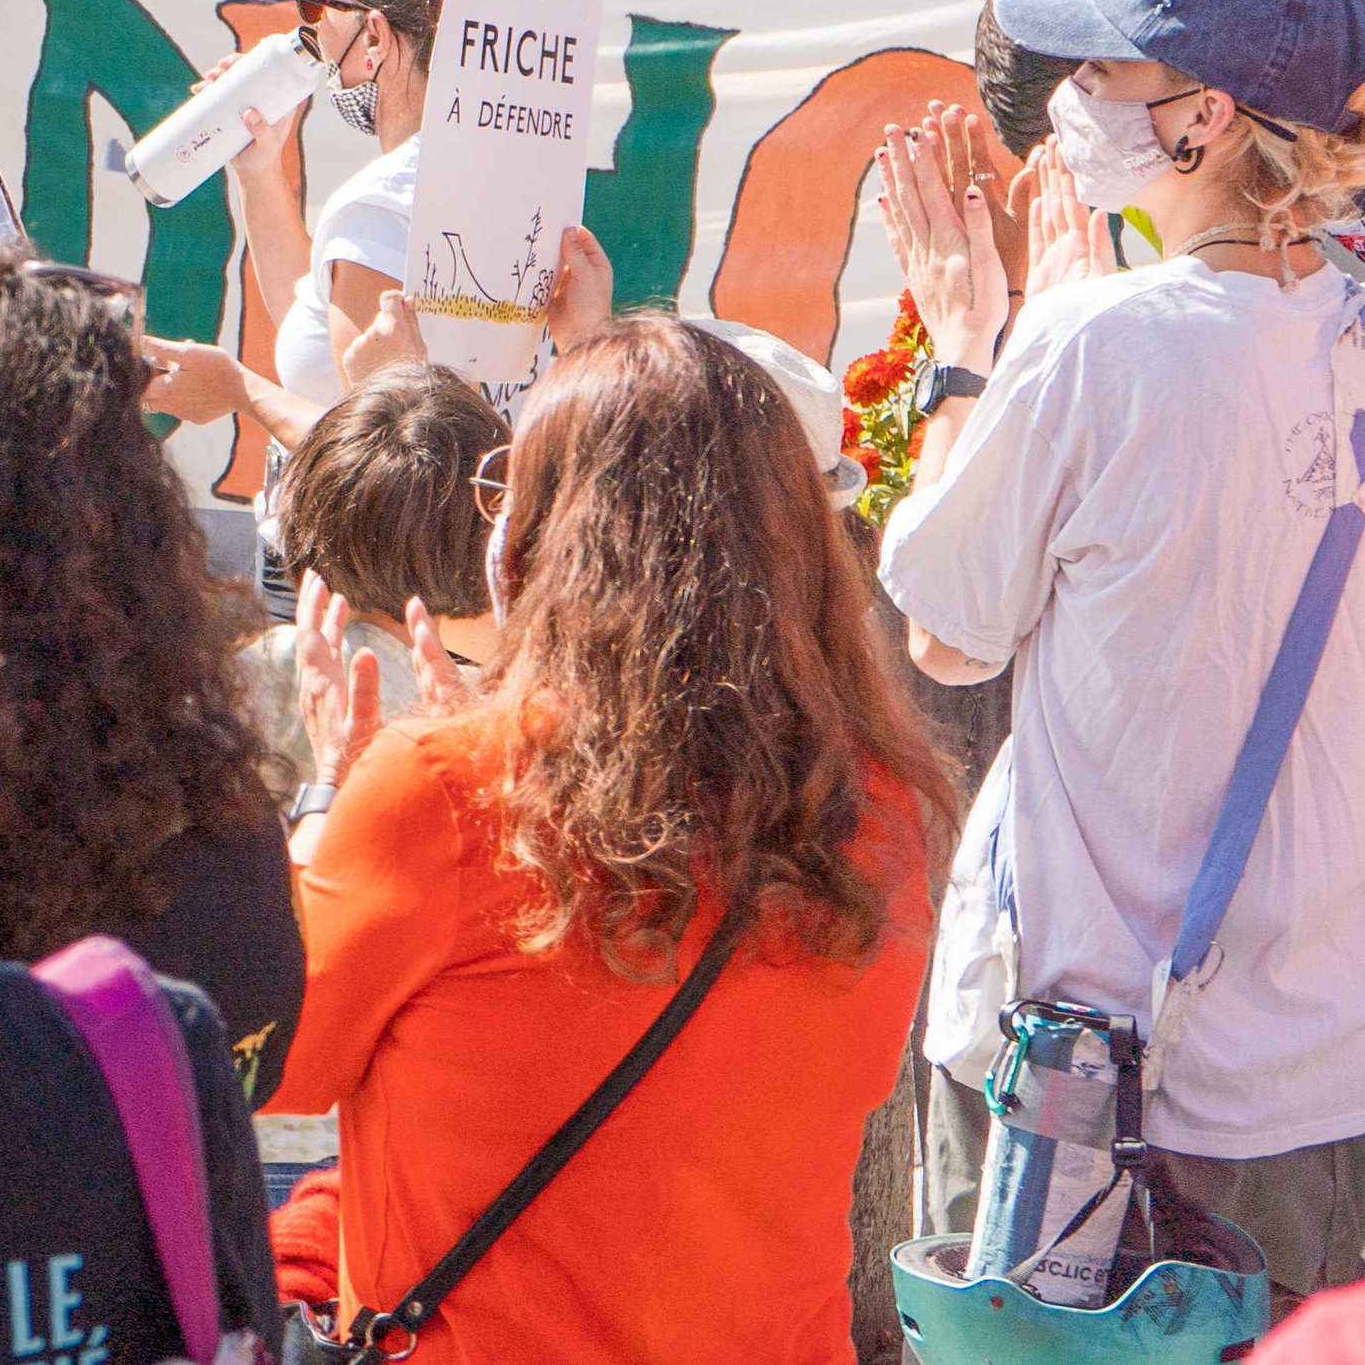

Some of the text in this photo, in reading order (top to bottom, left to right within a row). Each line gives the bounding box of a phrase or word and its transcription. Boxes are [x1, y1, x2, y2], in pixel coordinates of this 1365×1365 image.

[460, 19, 577, 84] FRICHE
[447, 87, 573, 140] À DÉFENDRE
